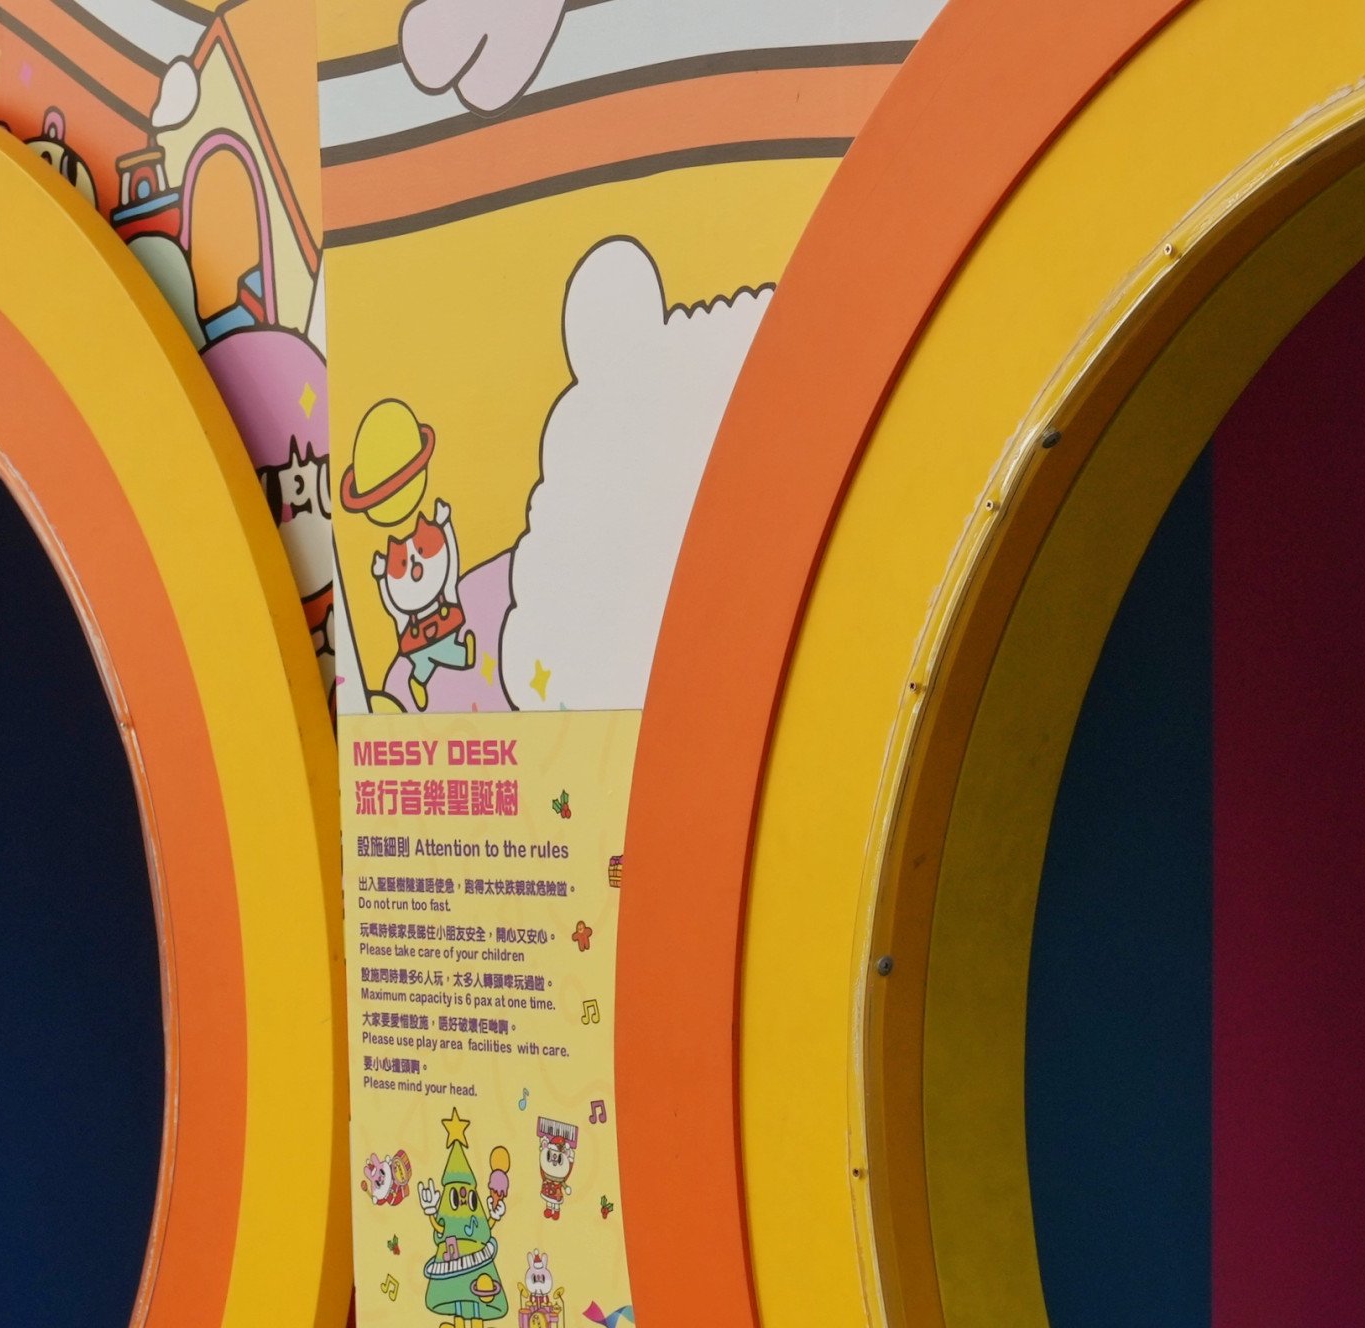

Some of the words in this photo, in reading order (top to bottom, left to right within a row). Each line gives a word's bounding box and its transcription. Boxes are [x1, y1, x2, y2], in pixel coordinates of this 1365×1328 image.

[353, 741, 437, 765] MESSY
[448, 740, 517, 765] DESK
[355, 779, 519, 816] 流行音樂聖誕樹
[358, 836, 410, 858] 設施細則
[415, 840, 480, 858] Attention
[485, 841, 499, 858] to
[503, 840, 526, 858] the
[530, 841, 568, 859] rules
[359, 896, 372, 910] Do
[374, 897, 391, 911] not
[392, 899, 409, 911] run
[411, 899, 427, 911] too
[430, 899, 451, 913] fast.
[360, 943, 392, 958] Please
[395, 945, 416, 958] take
[418, 947, 441, 959] care
[444, 946, 454, 960] of
[456, 949, 479, 963] your
[482, 947, 524, 962] children
[361, 987, 407, 1003] Maximum
[409, 990, 452, 1008] capacity
[454, 992, 463, 1005] is
[466, 993, 472, 1006] 6
[474, 996, 493, 1011] pax
[494, 995, 505, 1007] at
[507, 998, 527, 1009] one
[529, 996, 556, 1011] time.
[362, 1032, 394, 1046] Please
[396, 1035, 414, 1047] use
[416, 1034, 437, 1052] play
[439, 1038, 463, 1051] area
[468, 1038, 511, 1054] facilities
[517, 1040, 540, 1055] with
[542, 1043, 570, 1057] care.
[363, 1076, 395, 1091] Please
[397, 1079, 422, 1093] mind
[425, 1081, 447, 1097] your
[449, 1081, 477, 1097] head.
